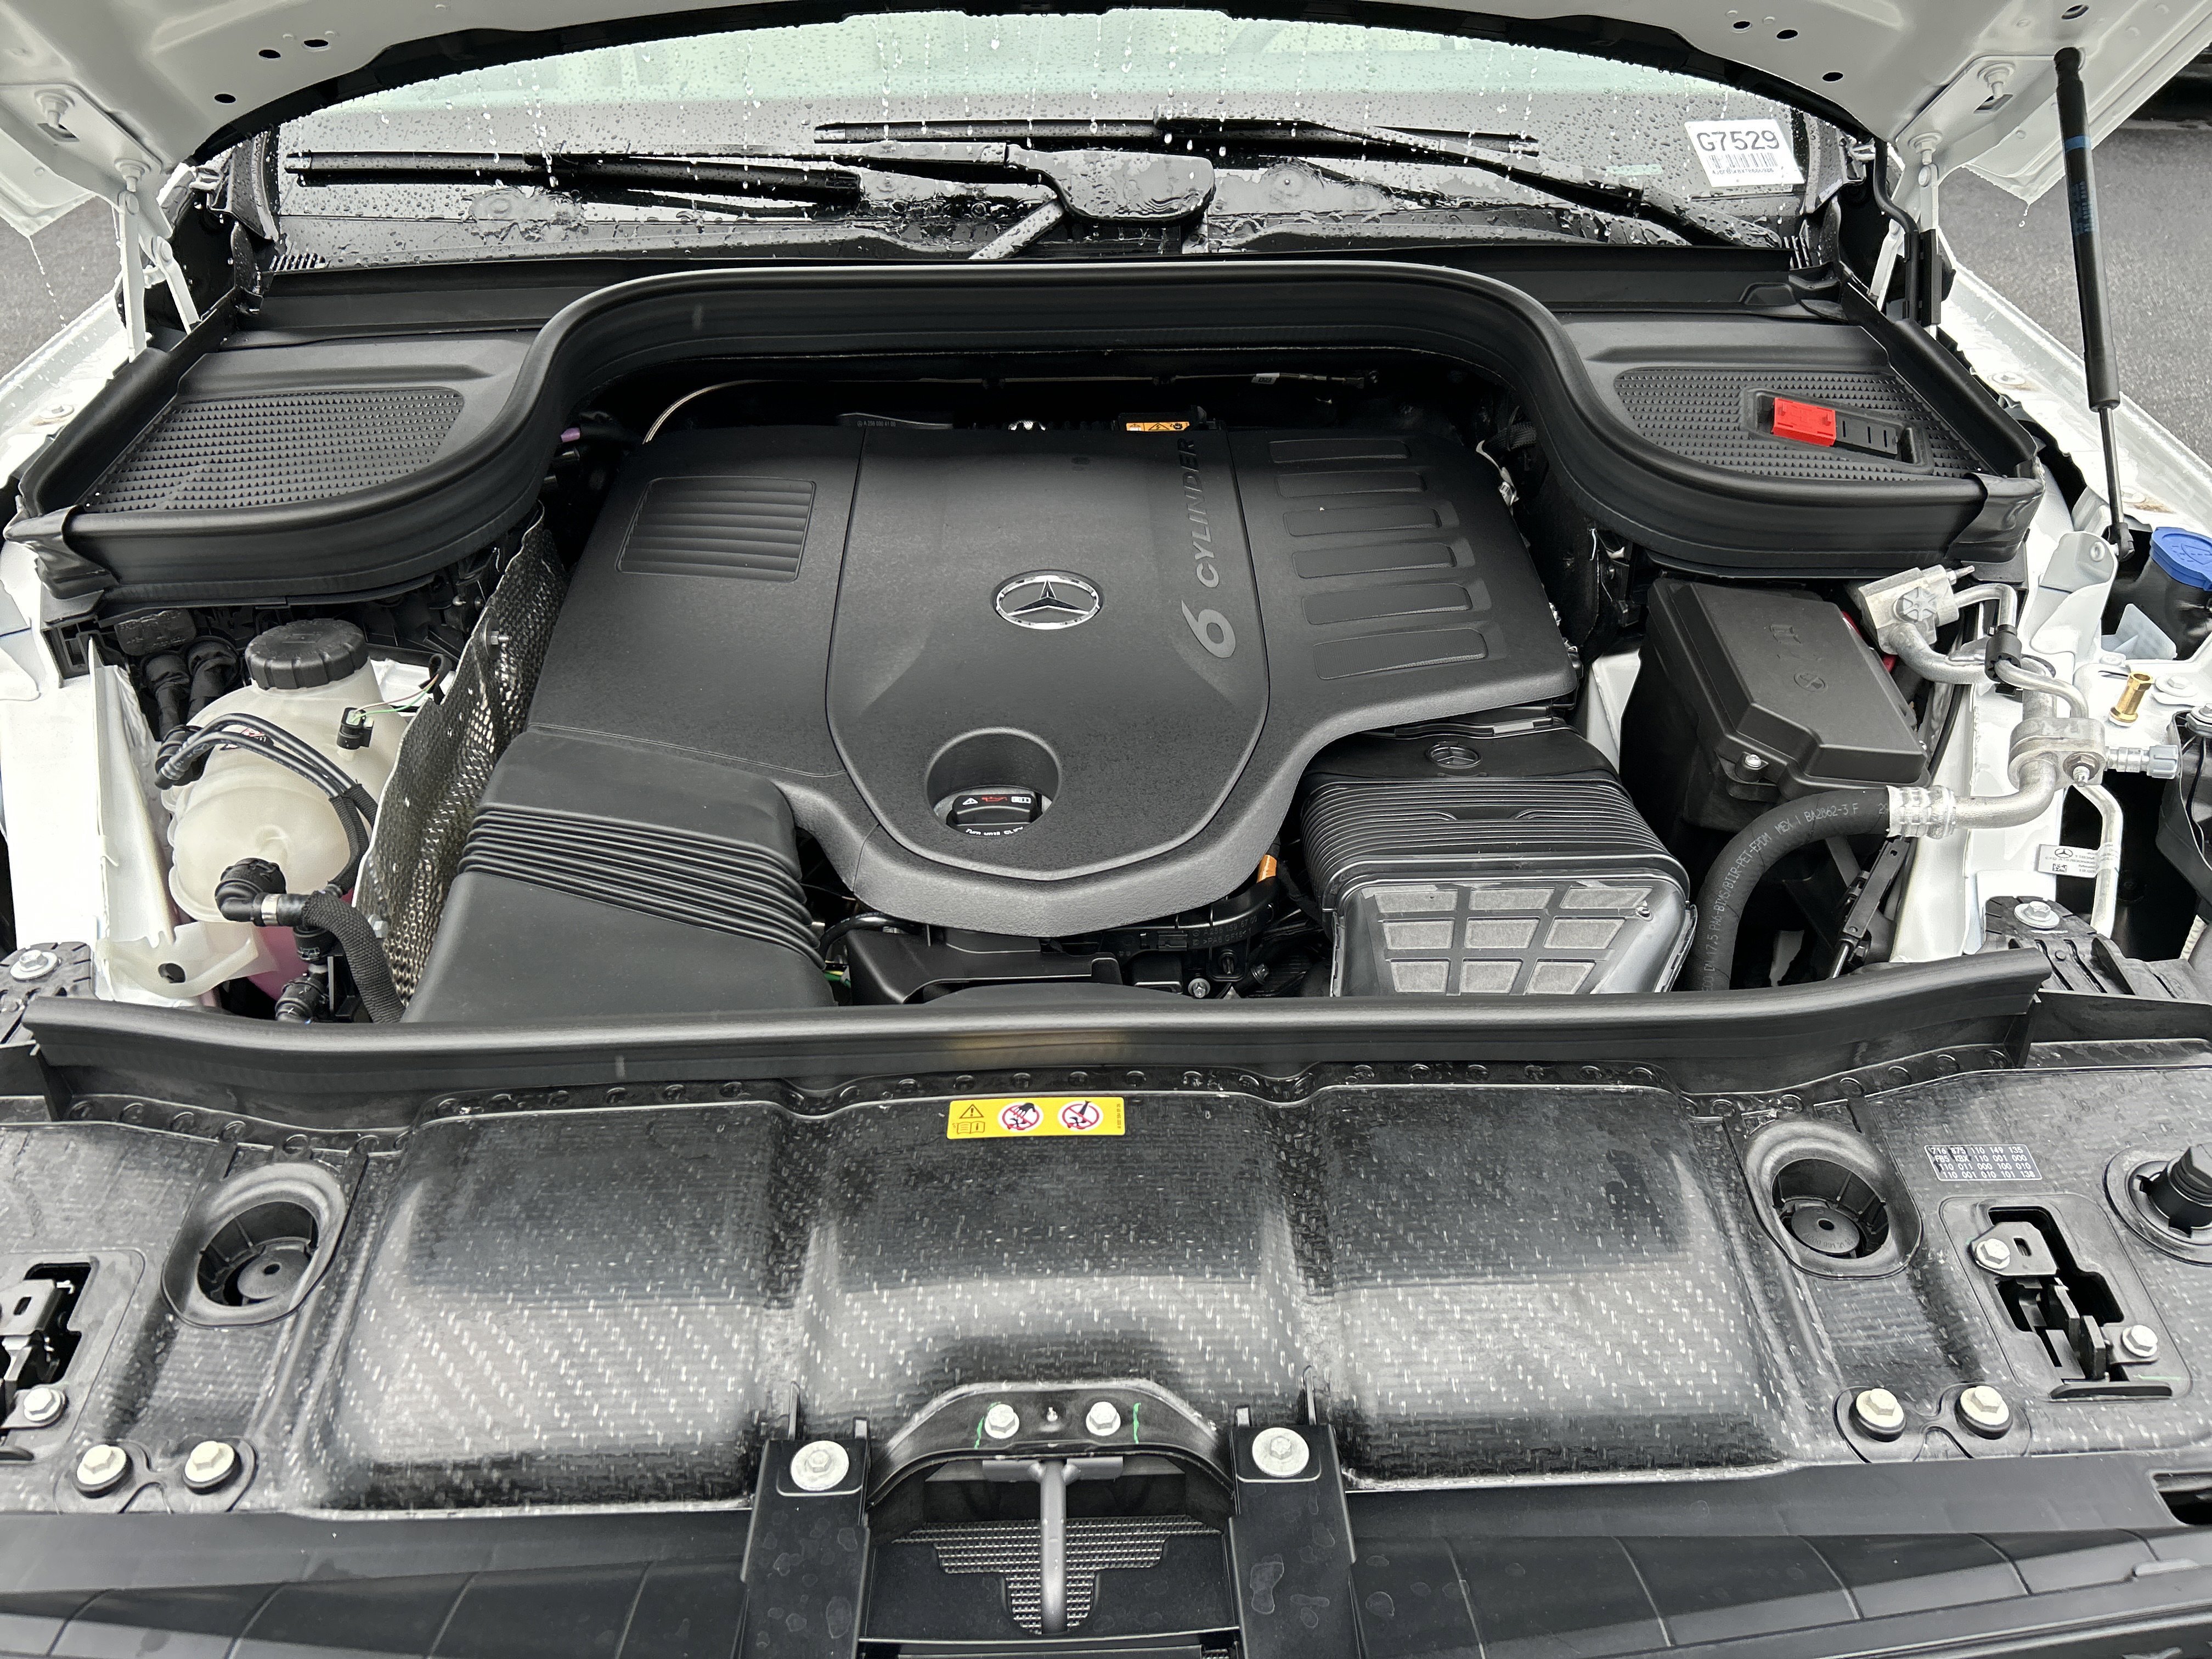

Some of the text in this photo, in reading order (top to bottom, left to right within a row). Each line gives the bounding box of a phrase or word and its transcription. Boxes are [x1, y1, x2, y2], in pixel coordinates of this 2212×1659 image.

[1696, 130, 1780, 151] G7529
[1177, 437, 1236, 658] 6 CYLINDER
[1774, 818, 1791, 834] MEX
[1804, 804, 1848, 822] BA2862-3
[1852, 803, 1859, 815] F
[1226, 923, 1238, 931] 159
